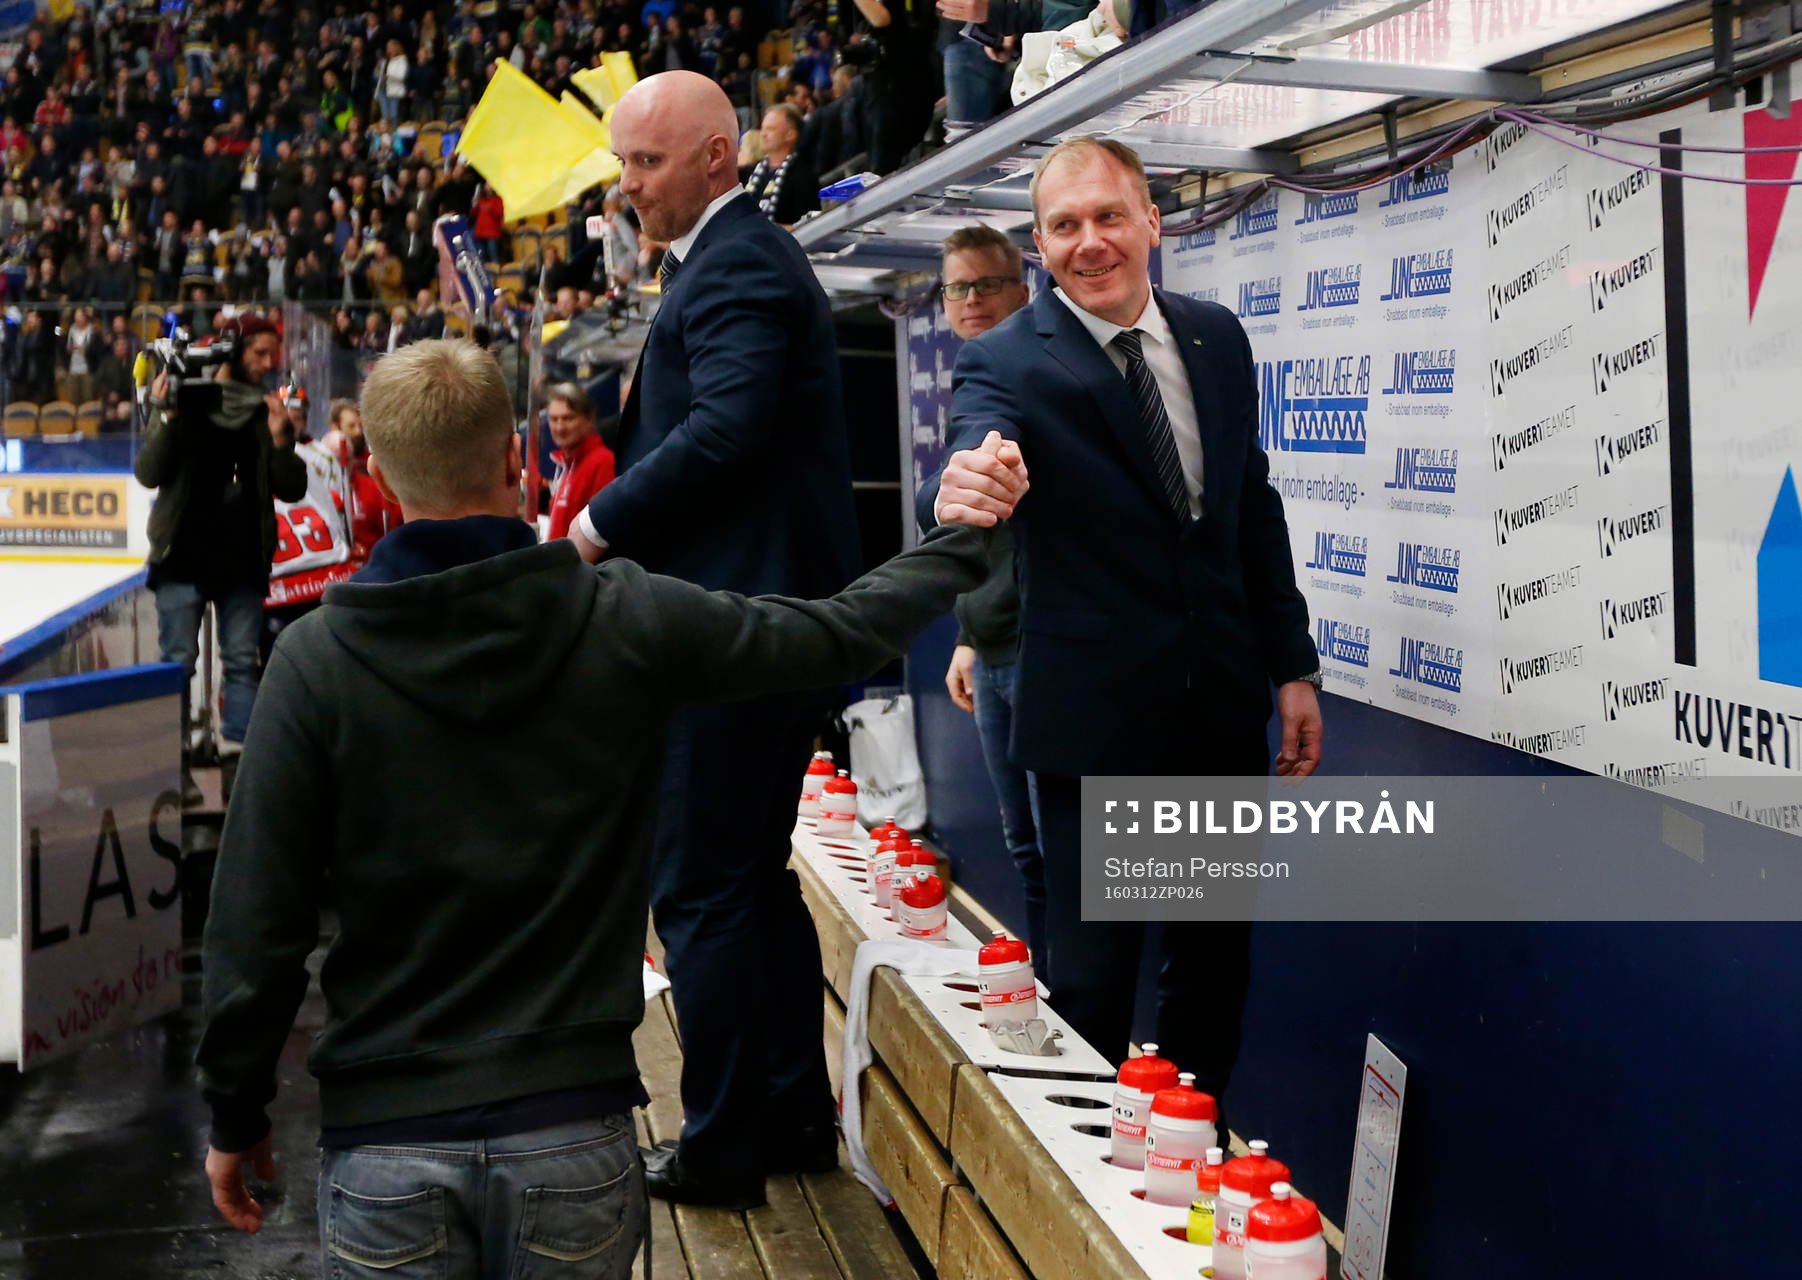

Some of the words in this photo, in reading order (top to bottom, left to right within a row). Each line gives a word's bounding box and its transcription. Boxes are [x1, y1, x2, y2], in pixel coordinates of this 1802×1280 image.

[1255, 359, 1293, 451] UNE
[1295, 356, 1353, 397] EMBALLAGE
[1354, 355, 1371, 396] AB
[22, 490, 118, 517] HECO
[1282, 474, 1304, 499] inom
[1306, 473, 1358, 511] emballage
[1115, 1107, 1133, 1118] 49
